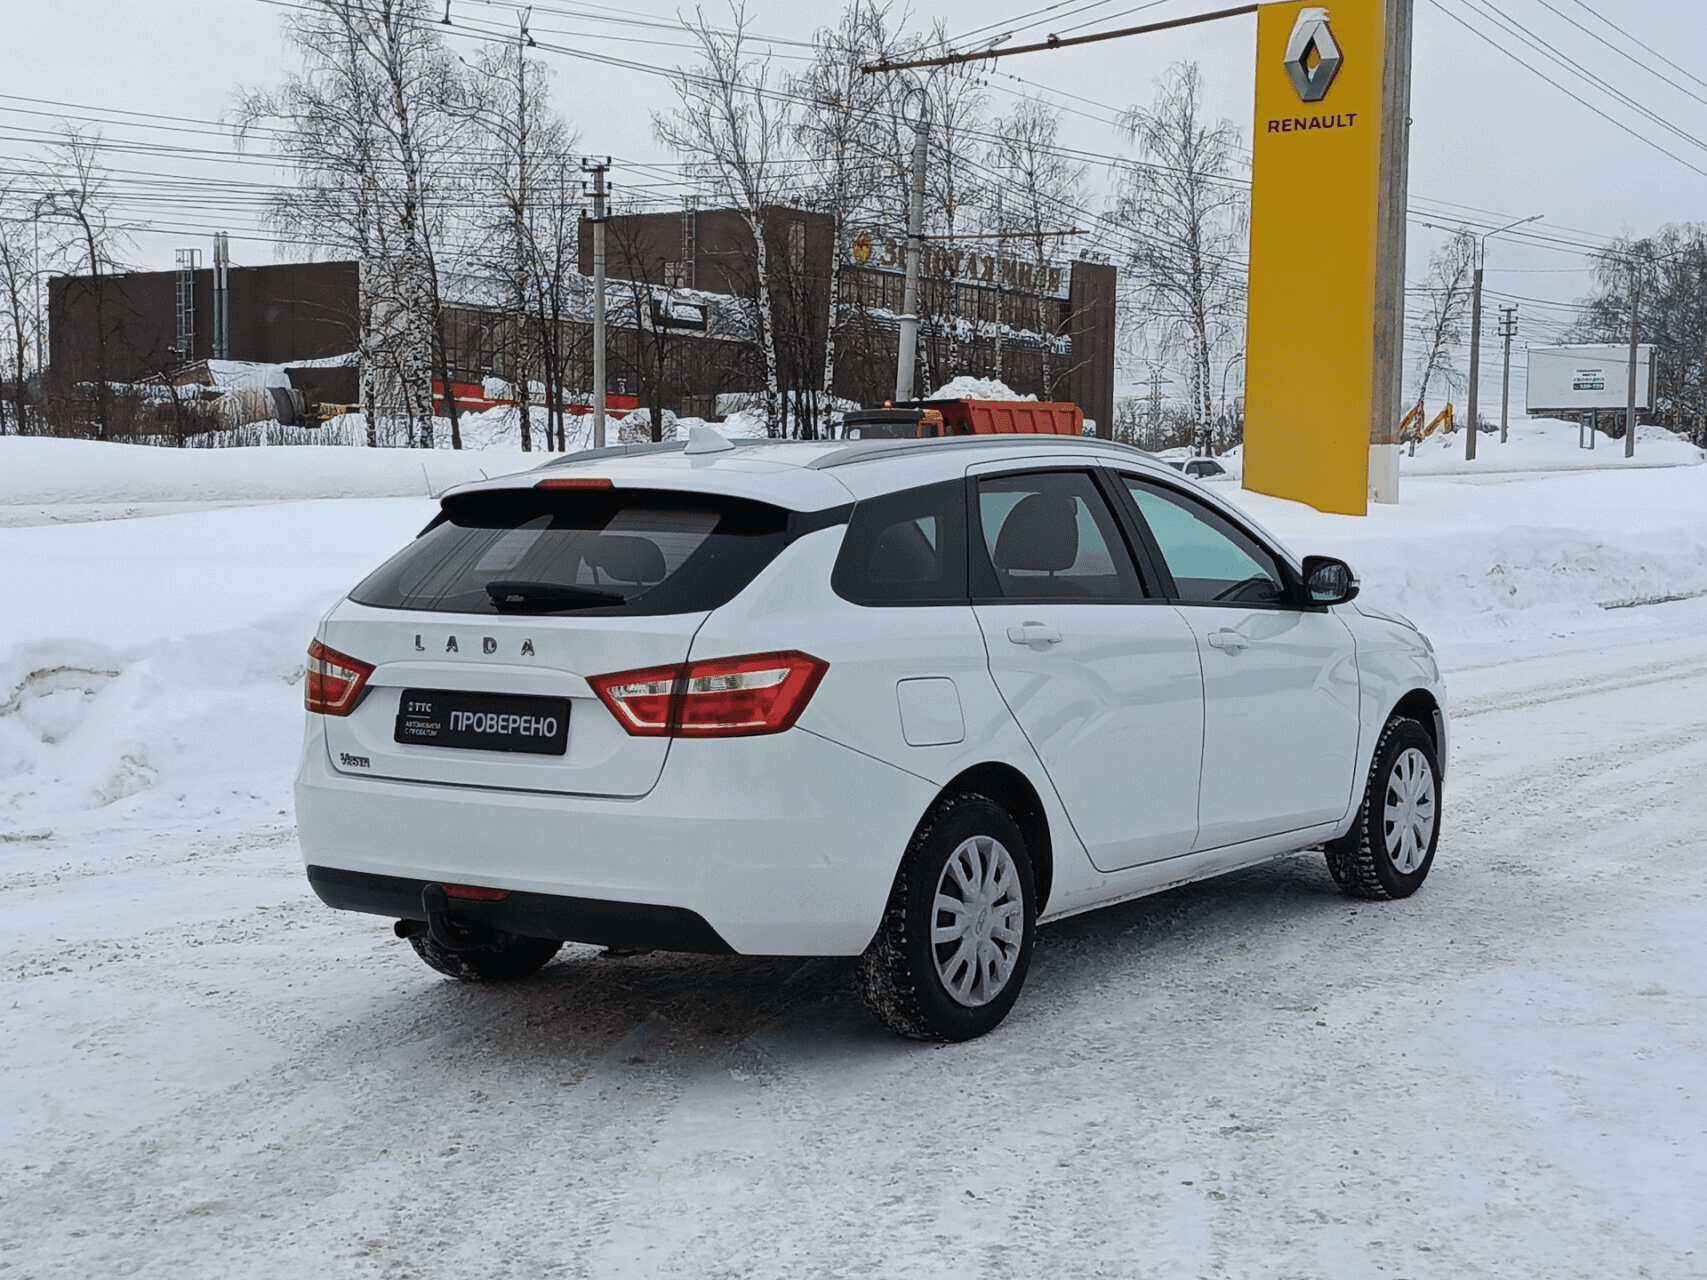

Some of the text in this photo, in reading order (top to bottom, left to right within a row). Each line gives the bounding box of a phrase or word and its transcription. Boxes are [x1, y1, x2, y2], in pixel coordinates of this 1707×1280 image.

[1268, 113, 1358, 133] RENAULT
[415, 634, 535, 656] LADA
[449, 711, 558, 738] ПРОВЕРЕНО
